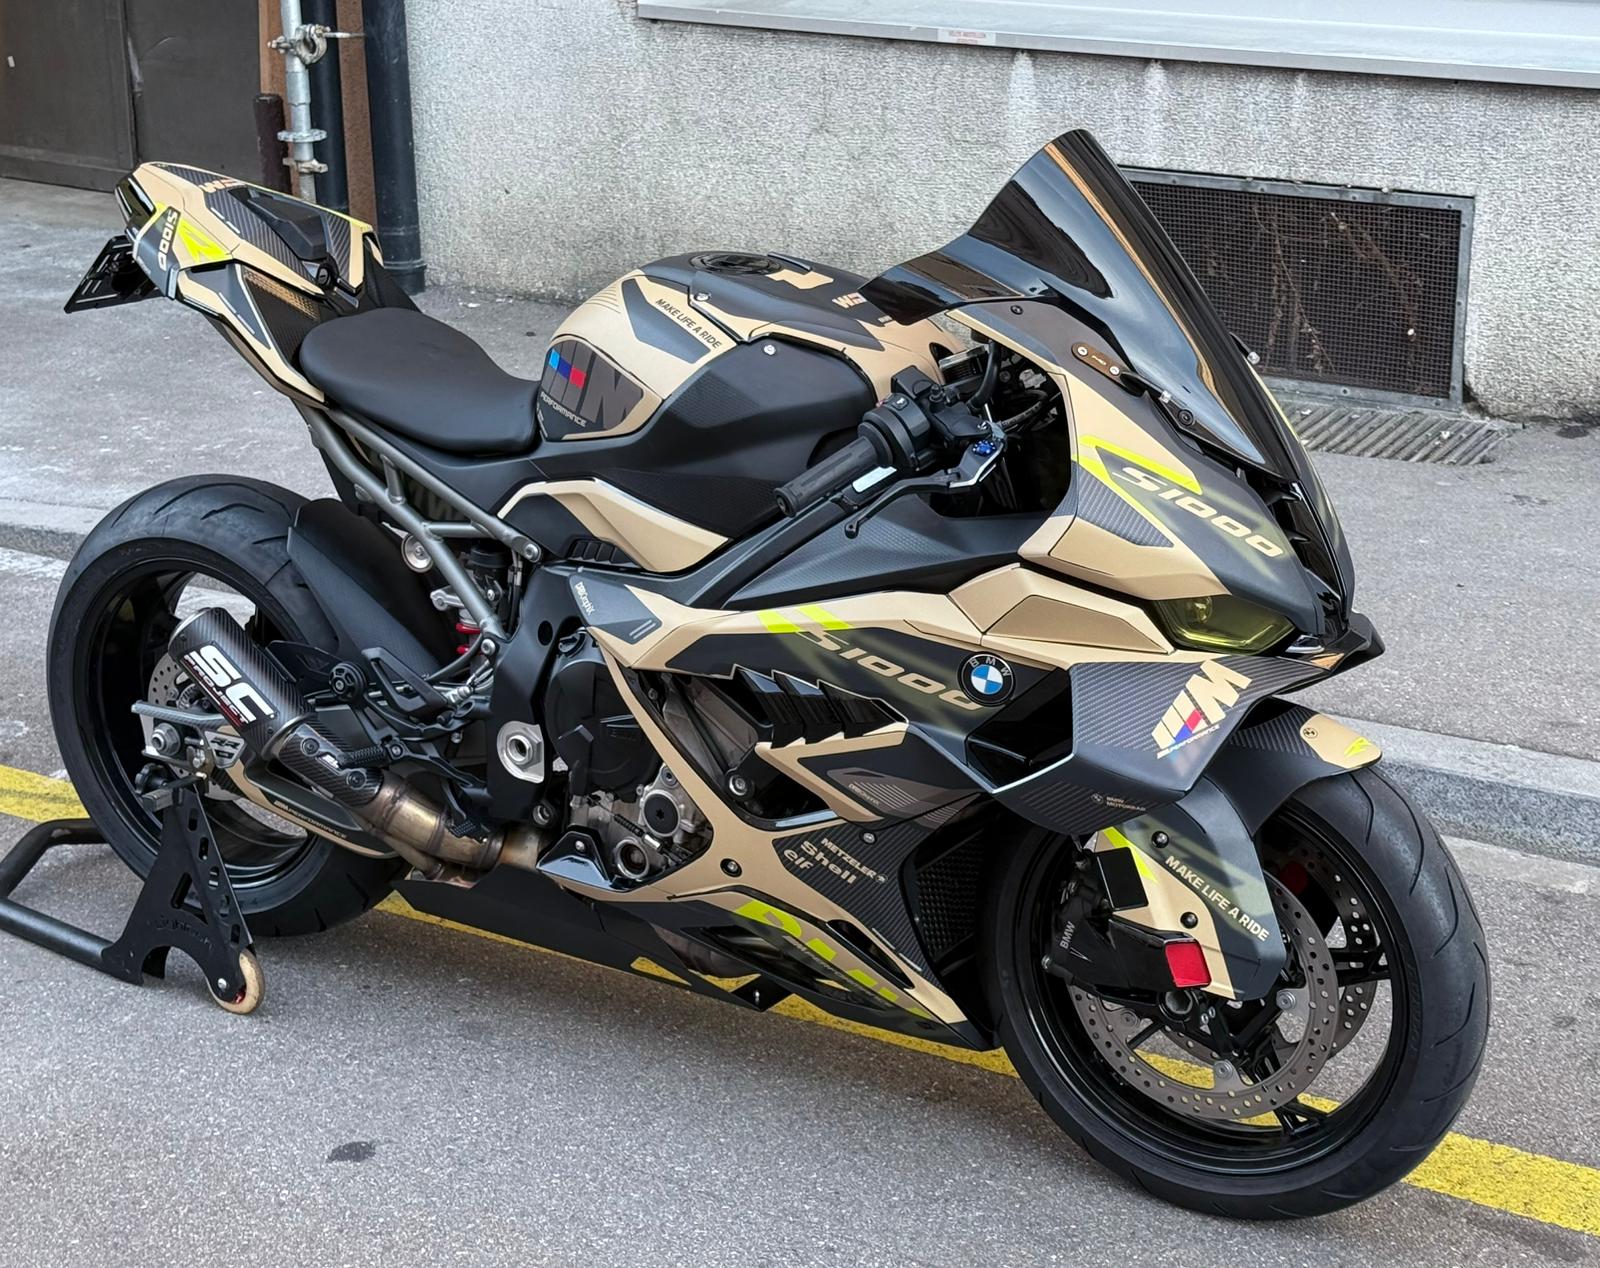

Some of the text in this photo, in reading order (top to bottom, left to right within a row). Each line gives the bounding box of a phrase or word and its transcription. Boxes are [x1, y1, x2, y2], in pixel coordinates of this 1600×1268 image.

[157, 209, 178, 272] S1000
[655, 298, 723, 349] MAKE LIFE A RIDE
[540, 391, 588, 428] PERFORMANCE
[1112, 466, 1284, 558] S1000
[183, 654, 249, 724] PROJECT
[189, 645, 275, 723] SC
[969, 656, 1012, 677] BMW
[783, 849, 814, 870] elf
[801, 840, 857, 884] Shell
[821, 837, 877, 879] METZELER
[1165, 855, 1270, 942] MAKE LIFE A RIDE
[1059, 921, 1076, 950] BMW
